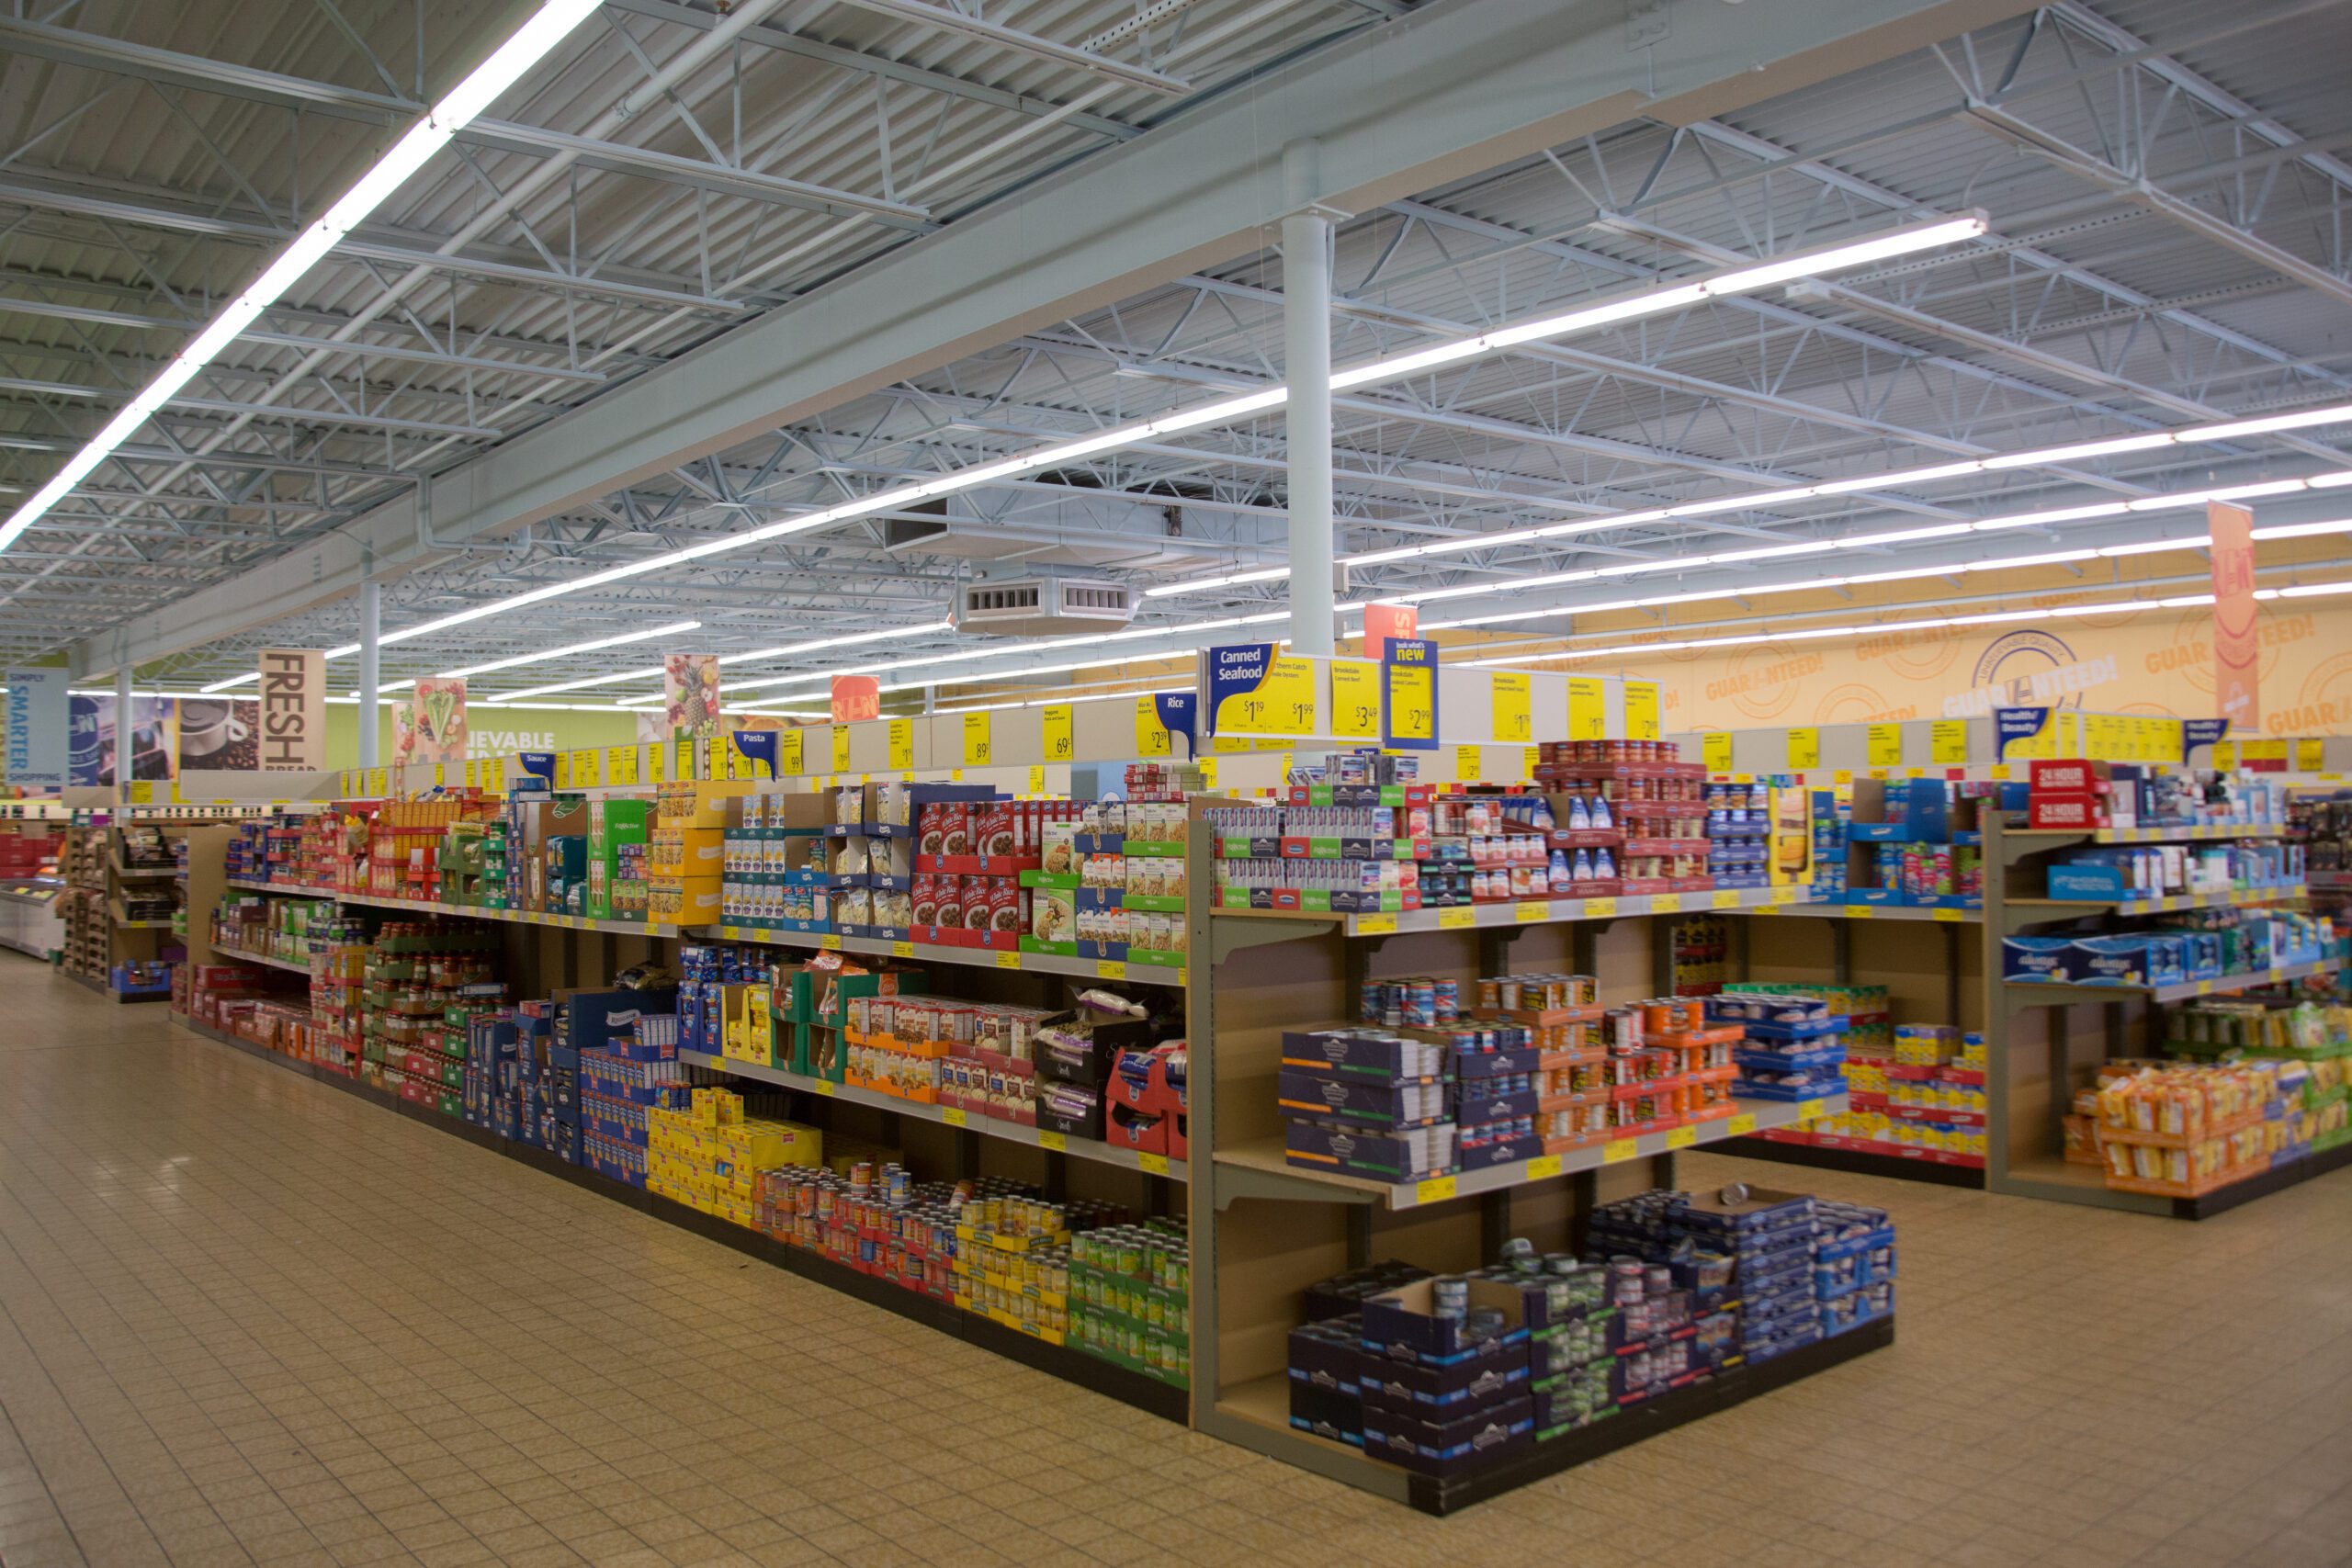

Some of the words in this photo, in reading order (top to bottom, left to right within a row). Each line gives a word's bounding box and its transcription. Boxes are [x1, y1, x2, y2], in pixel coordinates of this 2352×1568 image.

[1220, 648, 1261, 664] Canned
[1396, 648, 1425, 661] new
[1218, 665, 1262, 681] Seafood
[265, 653, 305, 764] FRESH
[1168, 696, 1184, 708] Rice
[9, 685, 29, 770] SMARTER
[743, 734, 765, 742] Pasta
[526, 754, 547, 762] Sauce
